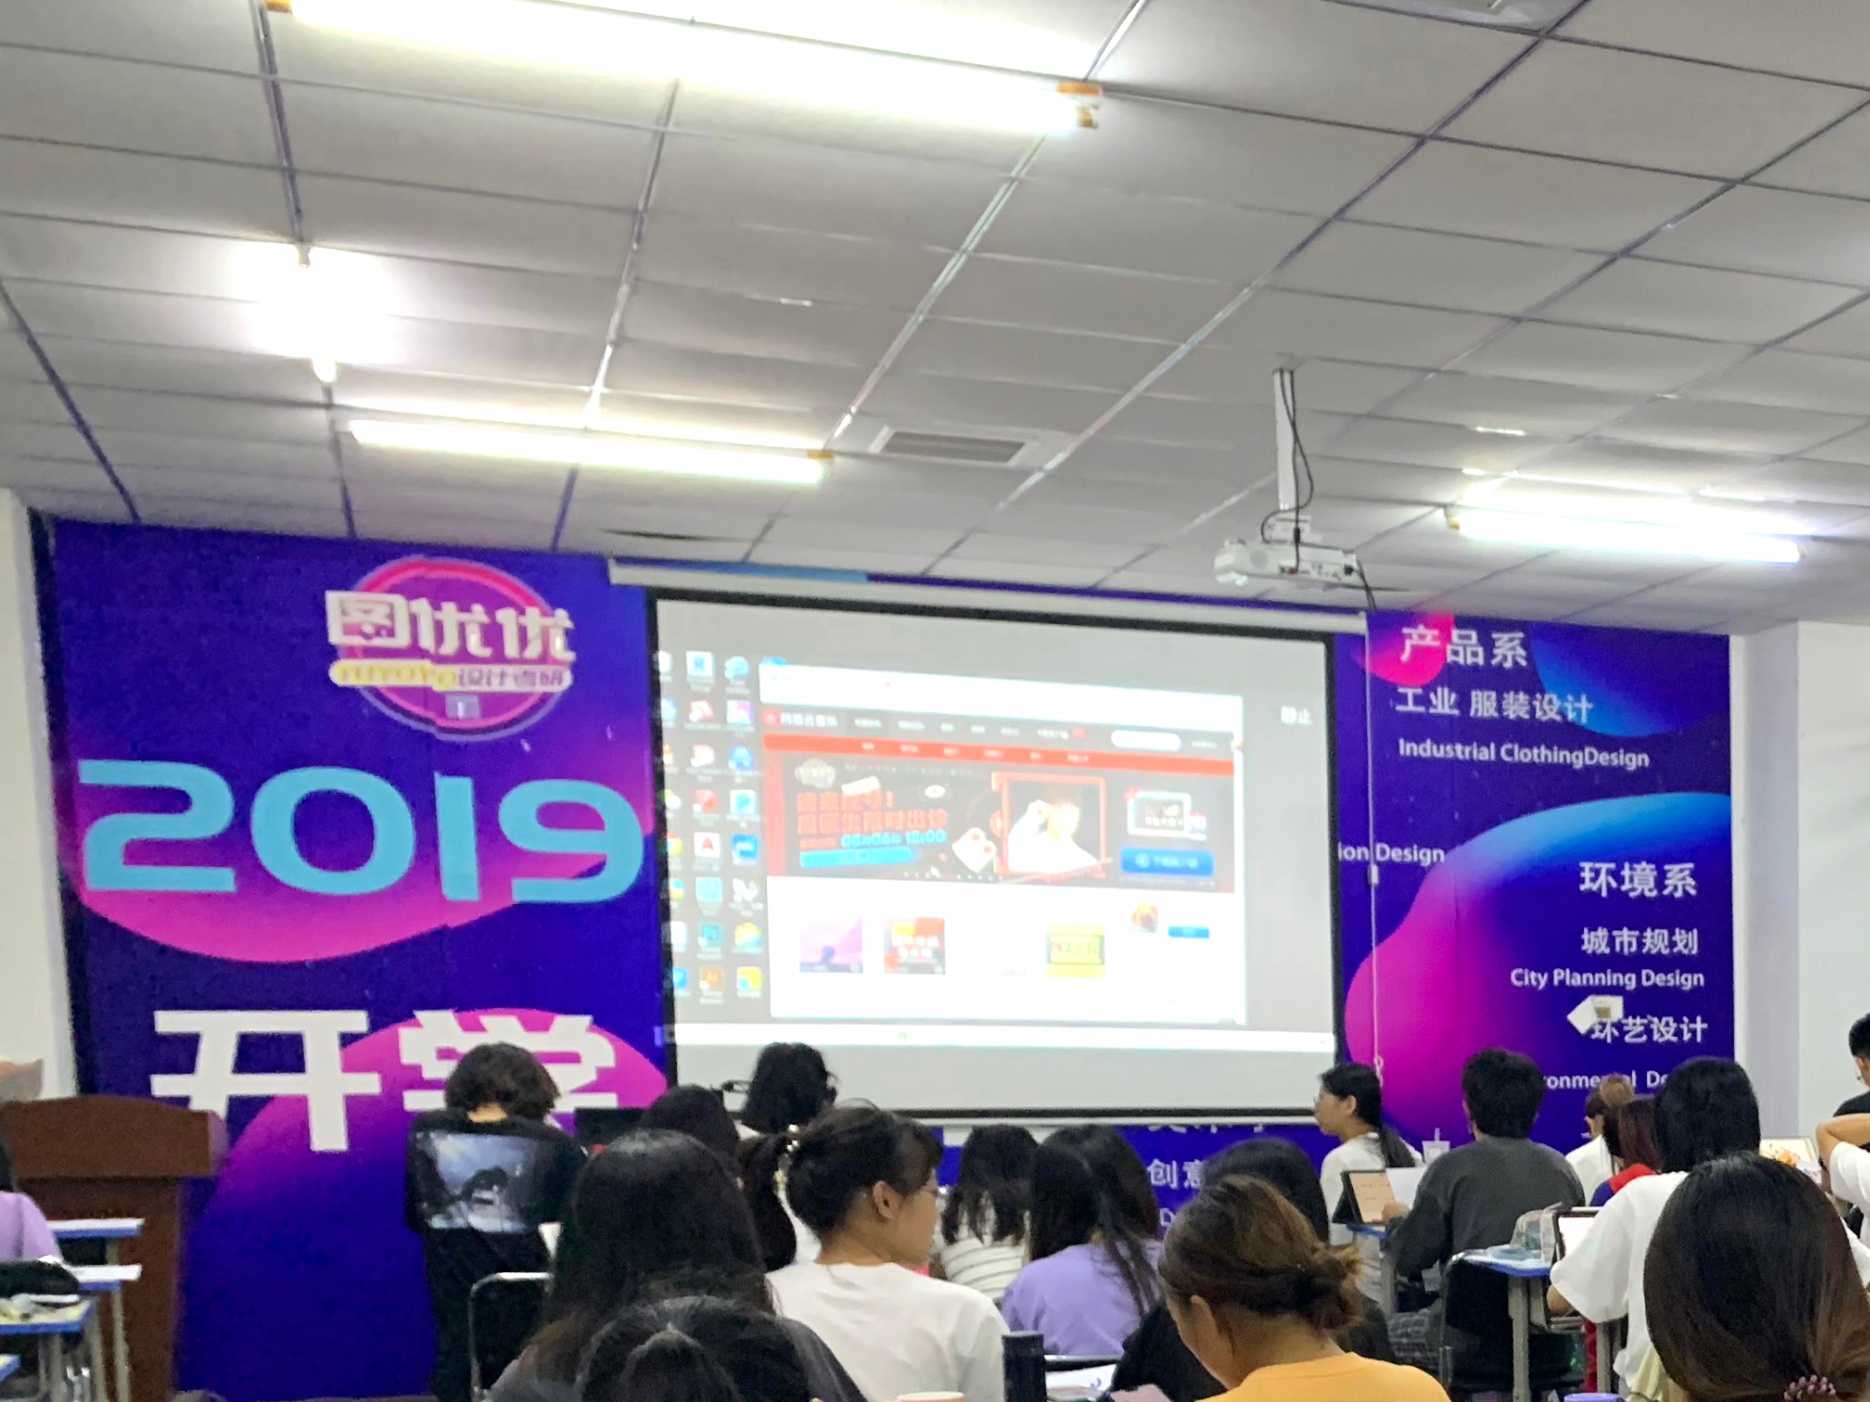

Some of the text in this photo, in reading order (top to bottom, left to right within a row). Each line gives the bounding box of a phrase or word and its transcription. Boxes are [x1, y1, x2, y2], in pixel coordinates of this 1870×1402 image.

[1401, 623, 1528, 668] 产品系
[1395, 686, 1594, 723] 工业 服装设计
[1398, 737, 1650, 769] Industrial ClothingDesign
[78, 759, 645, 904] 2019
[1375, 842, 1446, 867] Design
[1579, 861, 1698, 898] 环境系
[1581, 926, 1699, 956] 城市规划
[1510, 968, 1706, 991] City Planning Design
[1590, 1016, 1709, 1045] 环艺设计
